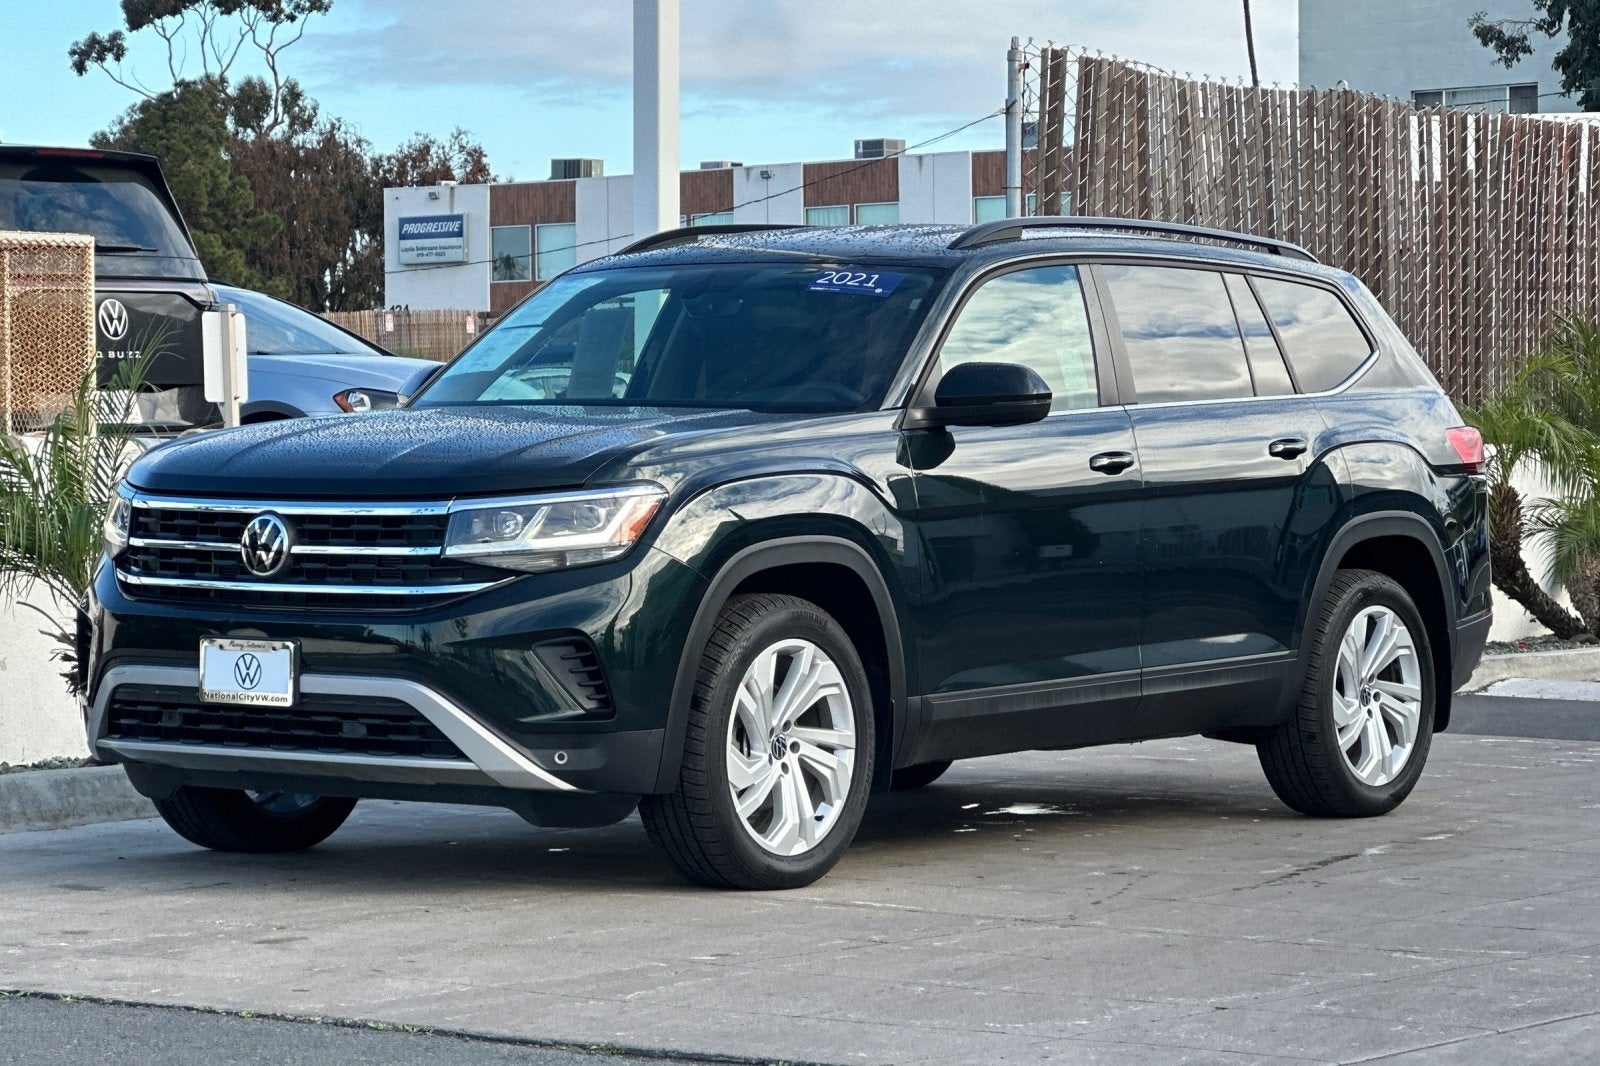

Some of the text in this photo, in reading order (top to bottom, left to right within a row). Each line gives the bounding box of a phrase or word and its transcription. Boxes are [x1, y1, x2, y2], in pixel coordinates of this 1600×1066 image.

[402, 221, 461, 234] PROGRESSIVE
[816, 271, 879, 287] 2021
[108, 350, 142, 359] BUZZ
[234, 652, 262, 690] VW
[203, 691, 289, 703] NationalCityVW.com
